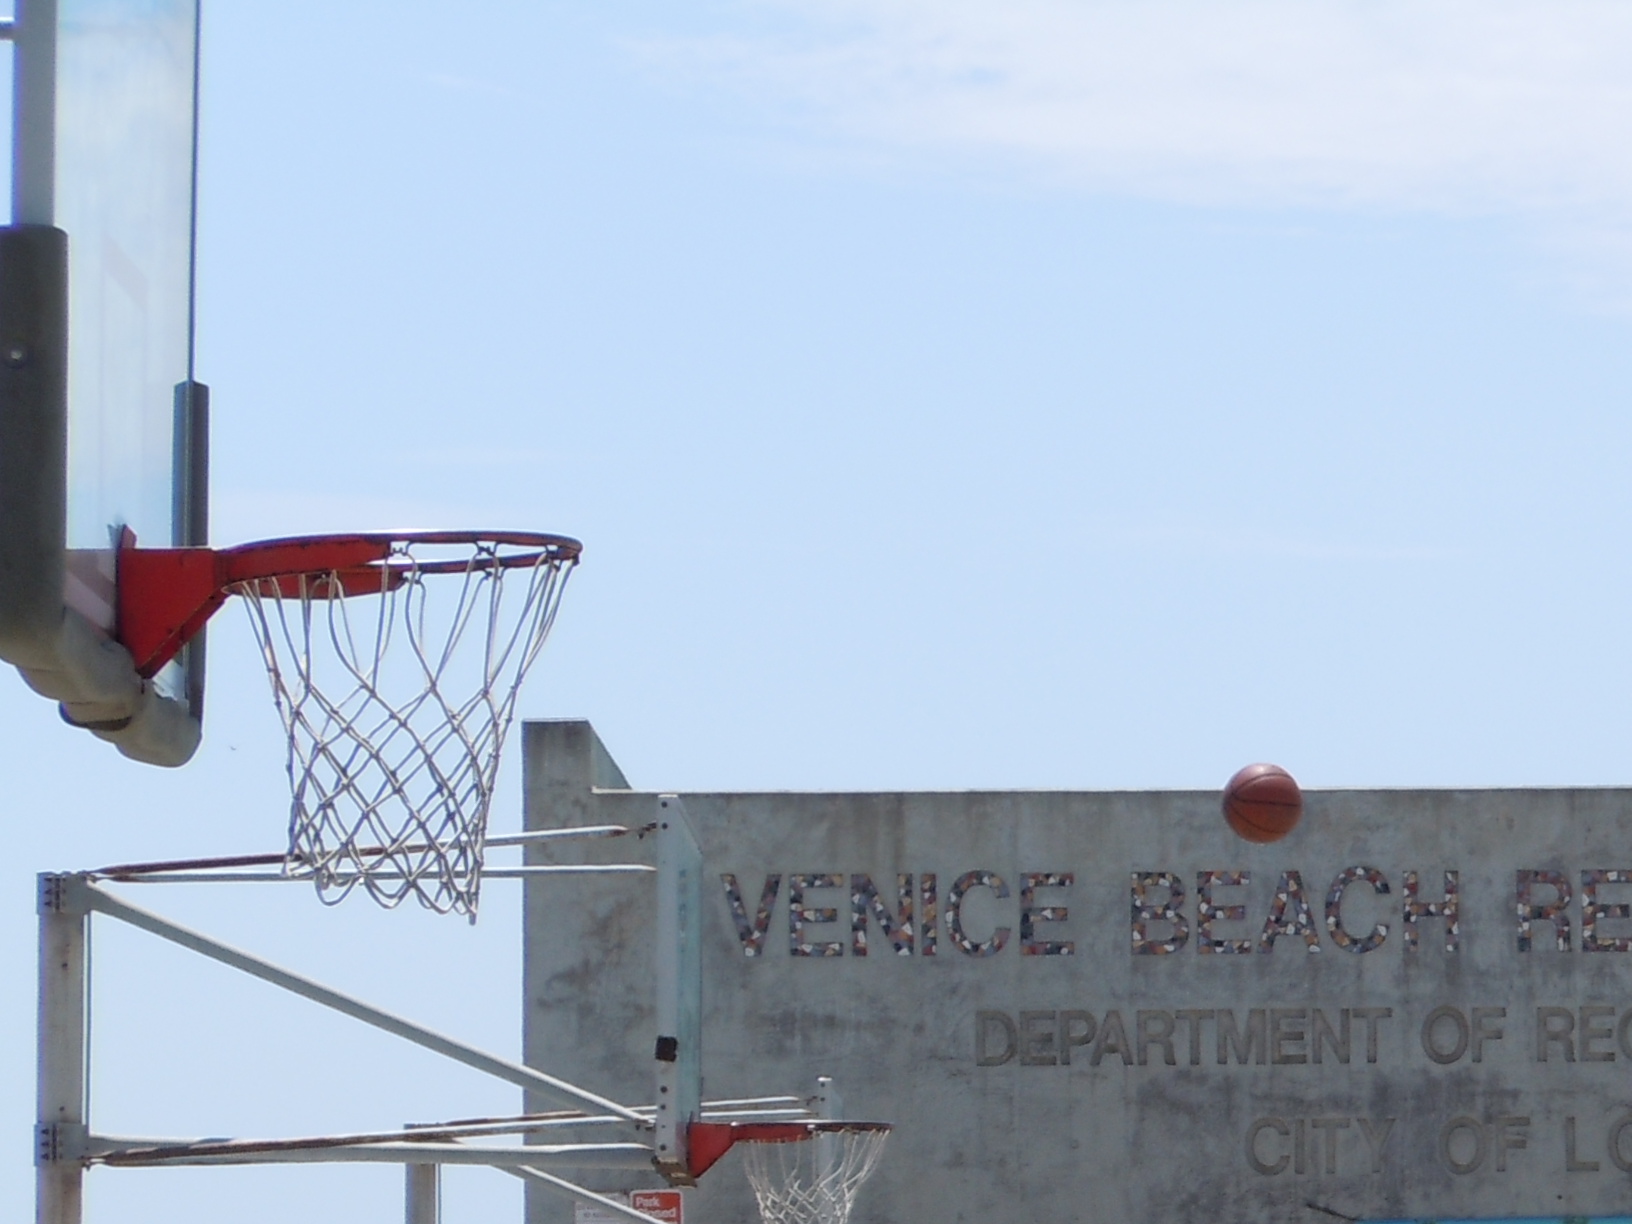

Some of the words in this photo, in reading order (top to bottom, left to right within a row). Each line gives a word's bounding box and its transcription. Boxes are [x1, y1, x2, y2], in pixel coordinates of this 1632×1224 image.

[719, 871, 1075, 957] VENICE
[1130, 865, 1459, 956] BEACH
[976, 1007, 1393, 1067] DEPARTMENT
[1419, 1005, 1504, 1064] OF
[1244, 1117, 1395, 1175] CITY
[1438, 1116, 1530, 1175] OF
